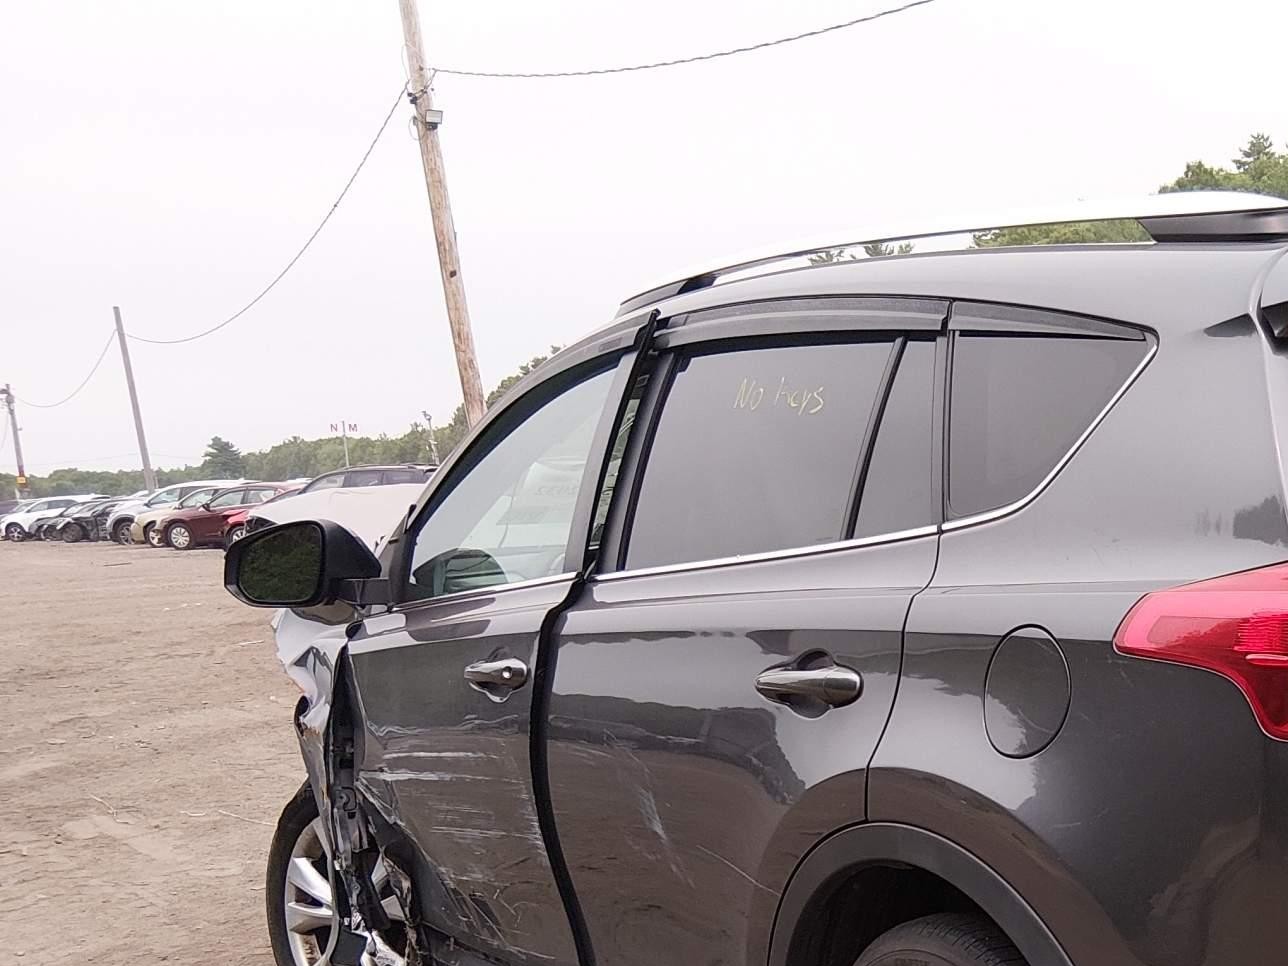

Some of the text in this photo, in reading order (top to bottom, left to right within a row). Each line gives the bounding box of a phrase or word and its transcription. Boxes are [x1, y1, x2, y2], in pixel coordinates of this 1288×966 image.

[732, 377, 764, 411] No
[330, 423, 338, 433] N
[348, 423, 358, 433] M
